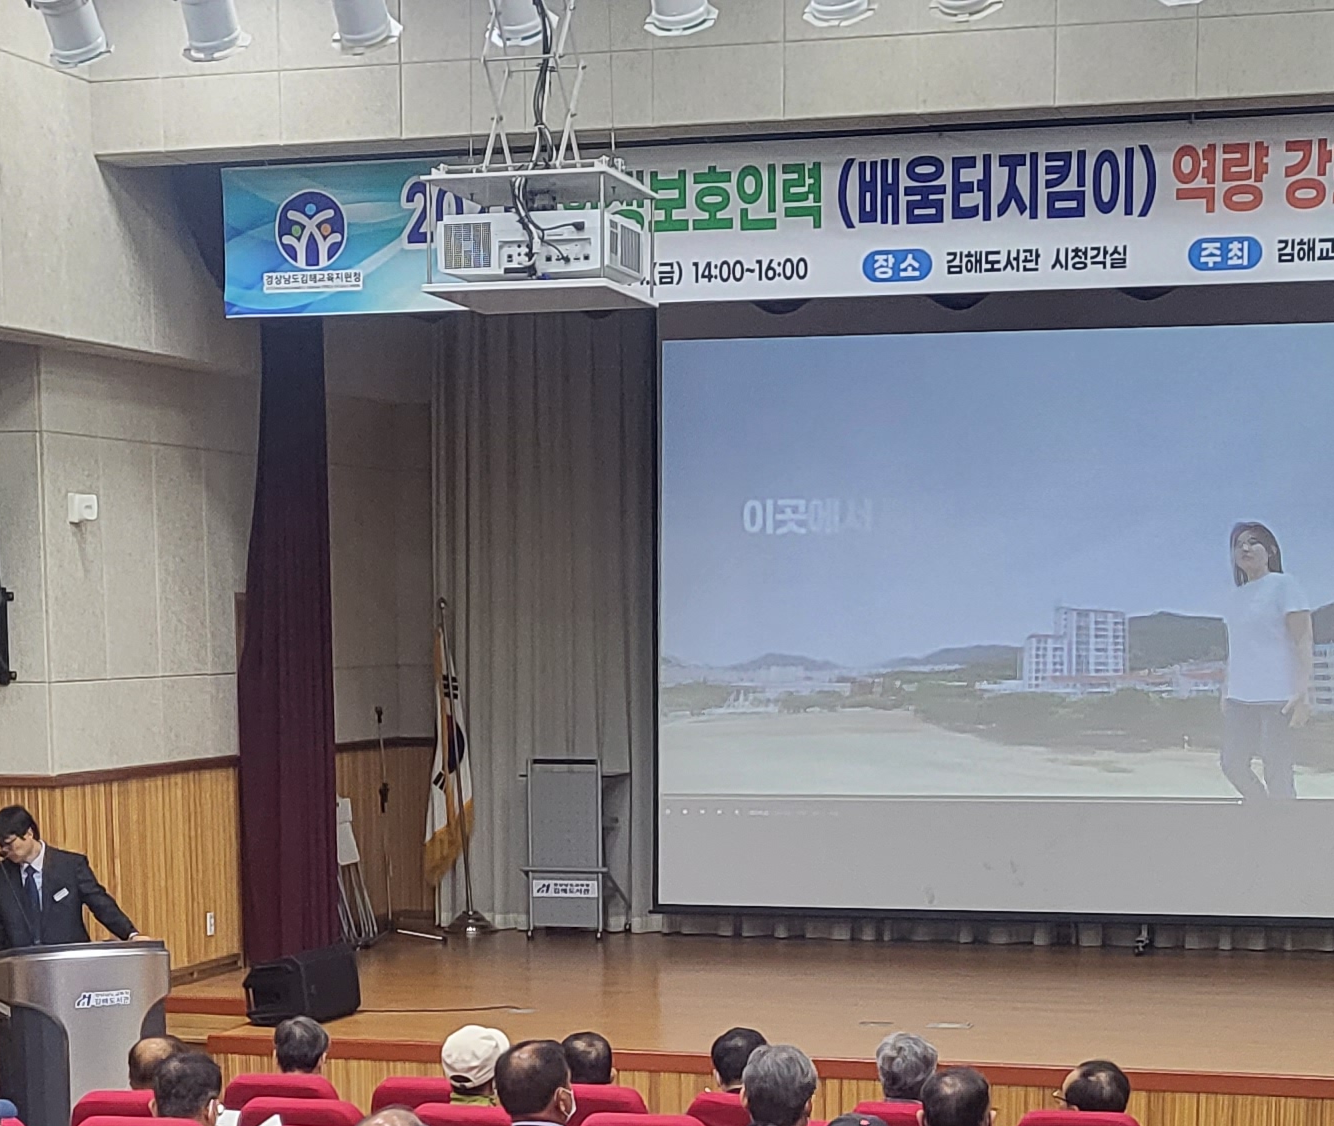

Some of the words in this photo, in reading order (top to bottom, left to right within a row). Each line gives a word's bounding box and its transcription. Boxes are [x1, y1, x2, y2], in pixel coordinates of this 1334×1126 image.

[562, 161, 822, 232] 보호인력
[838, 144, 1157, 229] (배움터지킴이)
[1172, 141, 1269, 214] 역량
[692, 257, 808, 284] 14:00~16:00
[873, 253, 921, 279] 장소
[946, 248, 1041, 275] 김해도서관
[1051, 244, 1128, 271] 시청각실
[1199, 241, 1249, 268] 주최
